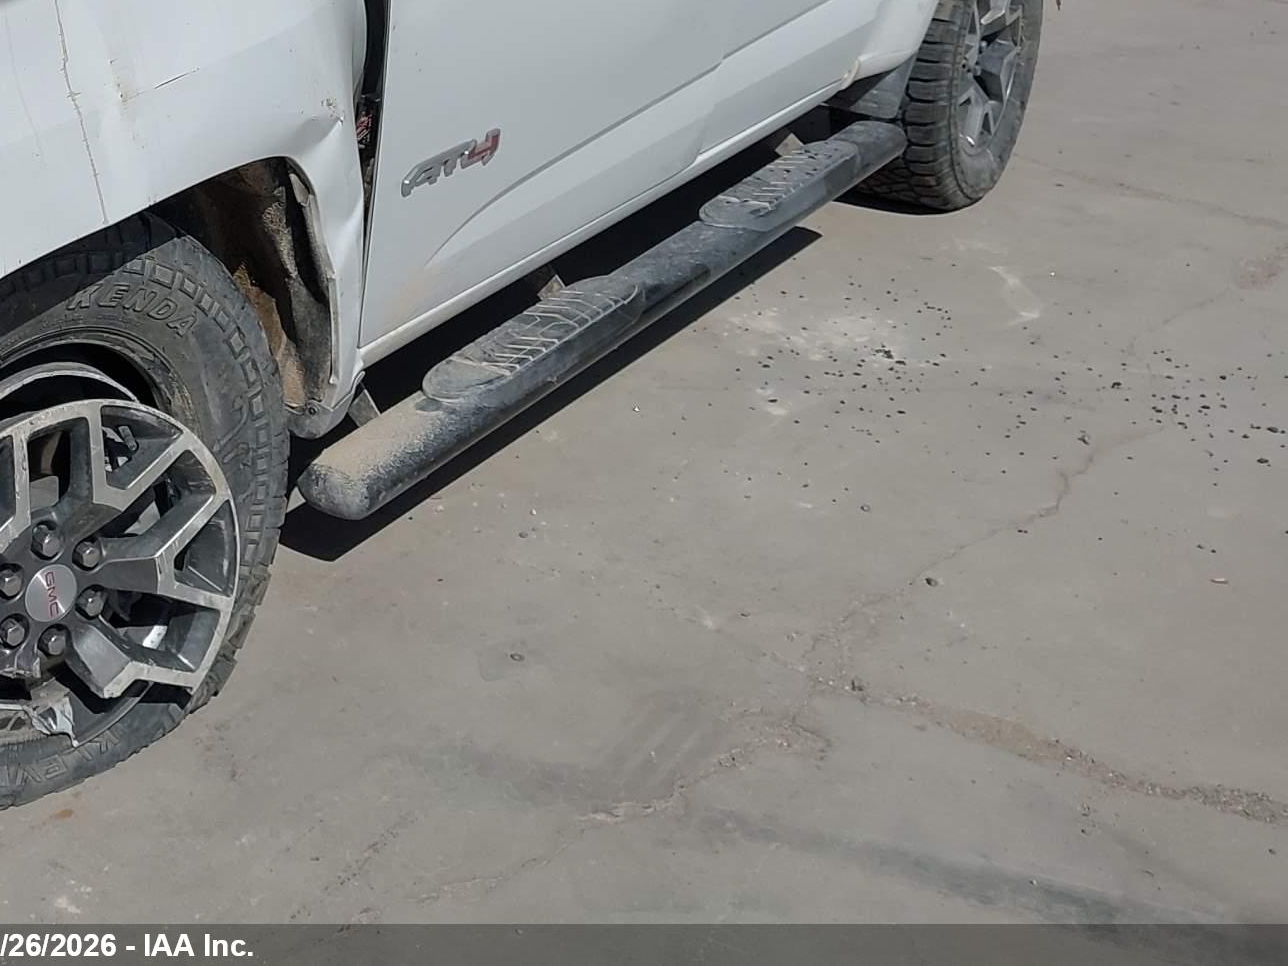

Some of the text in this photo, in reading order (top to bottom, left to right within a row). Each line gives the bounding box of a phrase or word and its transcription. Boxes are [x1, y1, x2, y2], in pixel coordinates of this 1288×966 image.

[400, 128, 501, 198] AT4
[66, 282, 198, 338] KENDA
[44, 570, 60, 619] GMC
